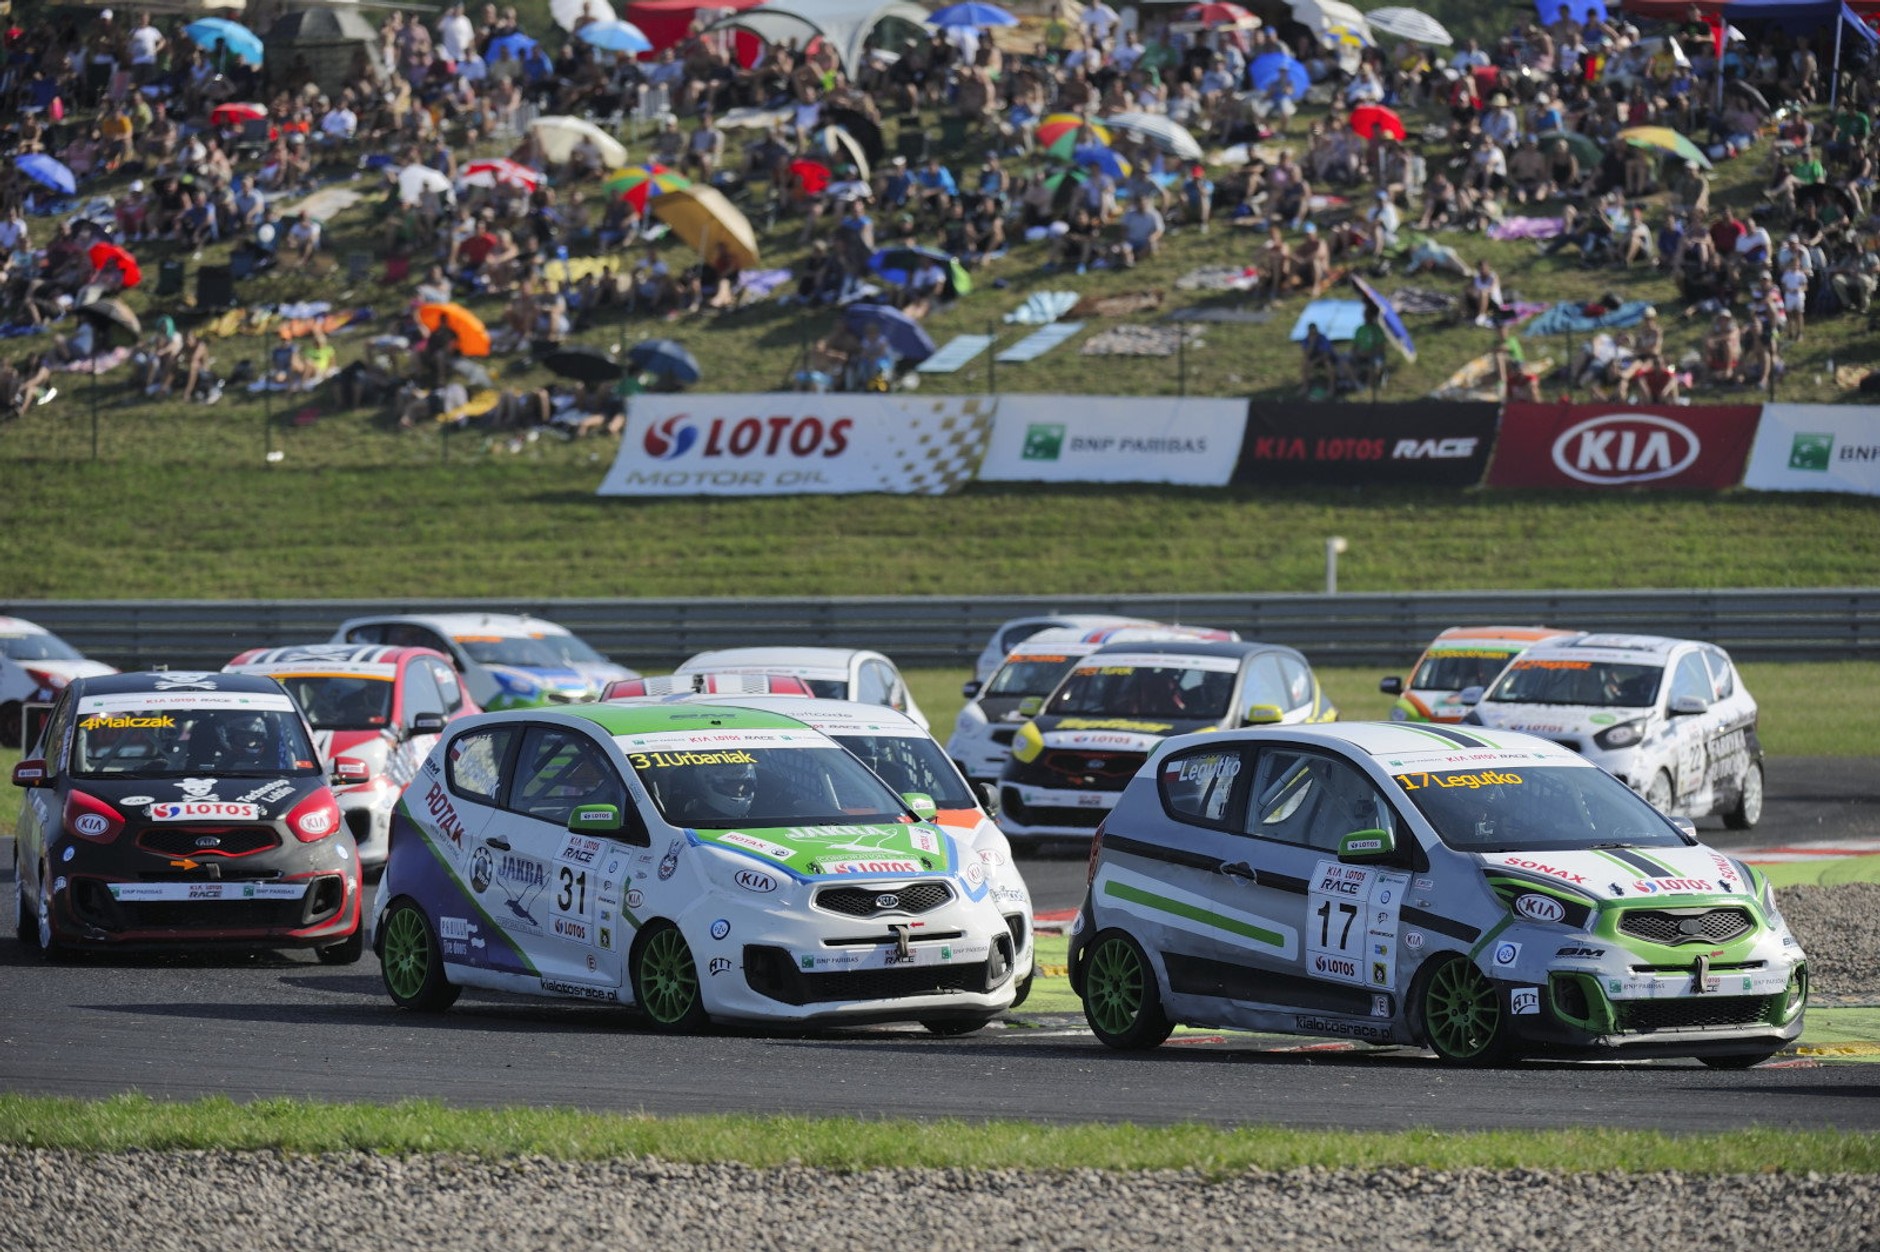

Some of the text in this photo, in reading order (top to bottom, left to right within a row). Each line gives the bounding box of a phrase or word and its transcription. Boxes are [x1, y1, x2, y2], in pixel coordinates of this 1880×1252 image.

[703, 416, 853, 459] LOTOS
[1070, 437, 1207, 453] BNP PARIBAS
[1255, 437, 1478, 460] KIA LOTOS RACE
[1577, 430, 1672, 470] KIA
[626, 469, 829, 486] MOTOR OIL
[1525, 724, 1563, 732] LOTOS
[1091, 735, 1131, 744] LOTOS
[1179, 756, 1241, 785] Legutko
[185, 804, 251, 816] LOTOS
[81, 818, 101, 830] KIA
[306, 817, 325, 828] KIA
[570, 836, 600, 852] KIA LOTOS
[727, 834, 765, 848] ROTAX
[563, 847, 594, 863] RACE
[499, 855, 544, 887] JAKRA
[1327, 866, 1366, 881] KIA LOTOS
[1504, 857, 1586, 883] SONAX
[741, 872, 769, 890] KIA
[1320, 878, 1360, 895] RACE
[1655, 879, 1713, 891] LOTOS
[189, 890, 222, 898] RACE
[558, 866, 586, 915] 31
[628, 893, 641, 905] KIA
[1525, 899, 1554, 918] KIA
[564, 921, 585, 940] LOTOS
[1317, 901, 1357, 951] 17
[1407, 934, 1421, 944] KIA
[709, 957, 733, 974] ATT
[832, 956, 859, 964] PARIBAS
[1328, 961, 1355, 977] LOTOS
[540, 977, 617, 1003] kialotosrace.pl
[1639, 982, 1665, 990] PARIBAS
[1513, 993, 1537, 1012] ATT
[1296, 1015, 1393, 1040] kialotosrace.pl
